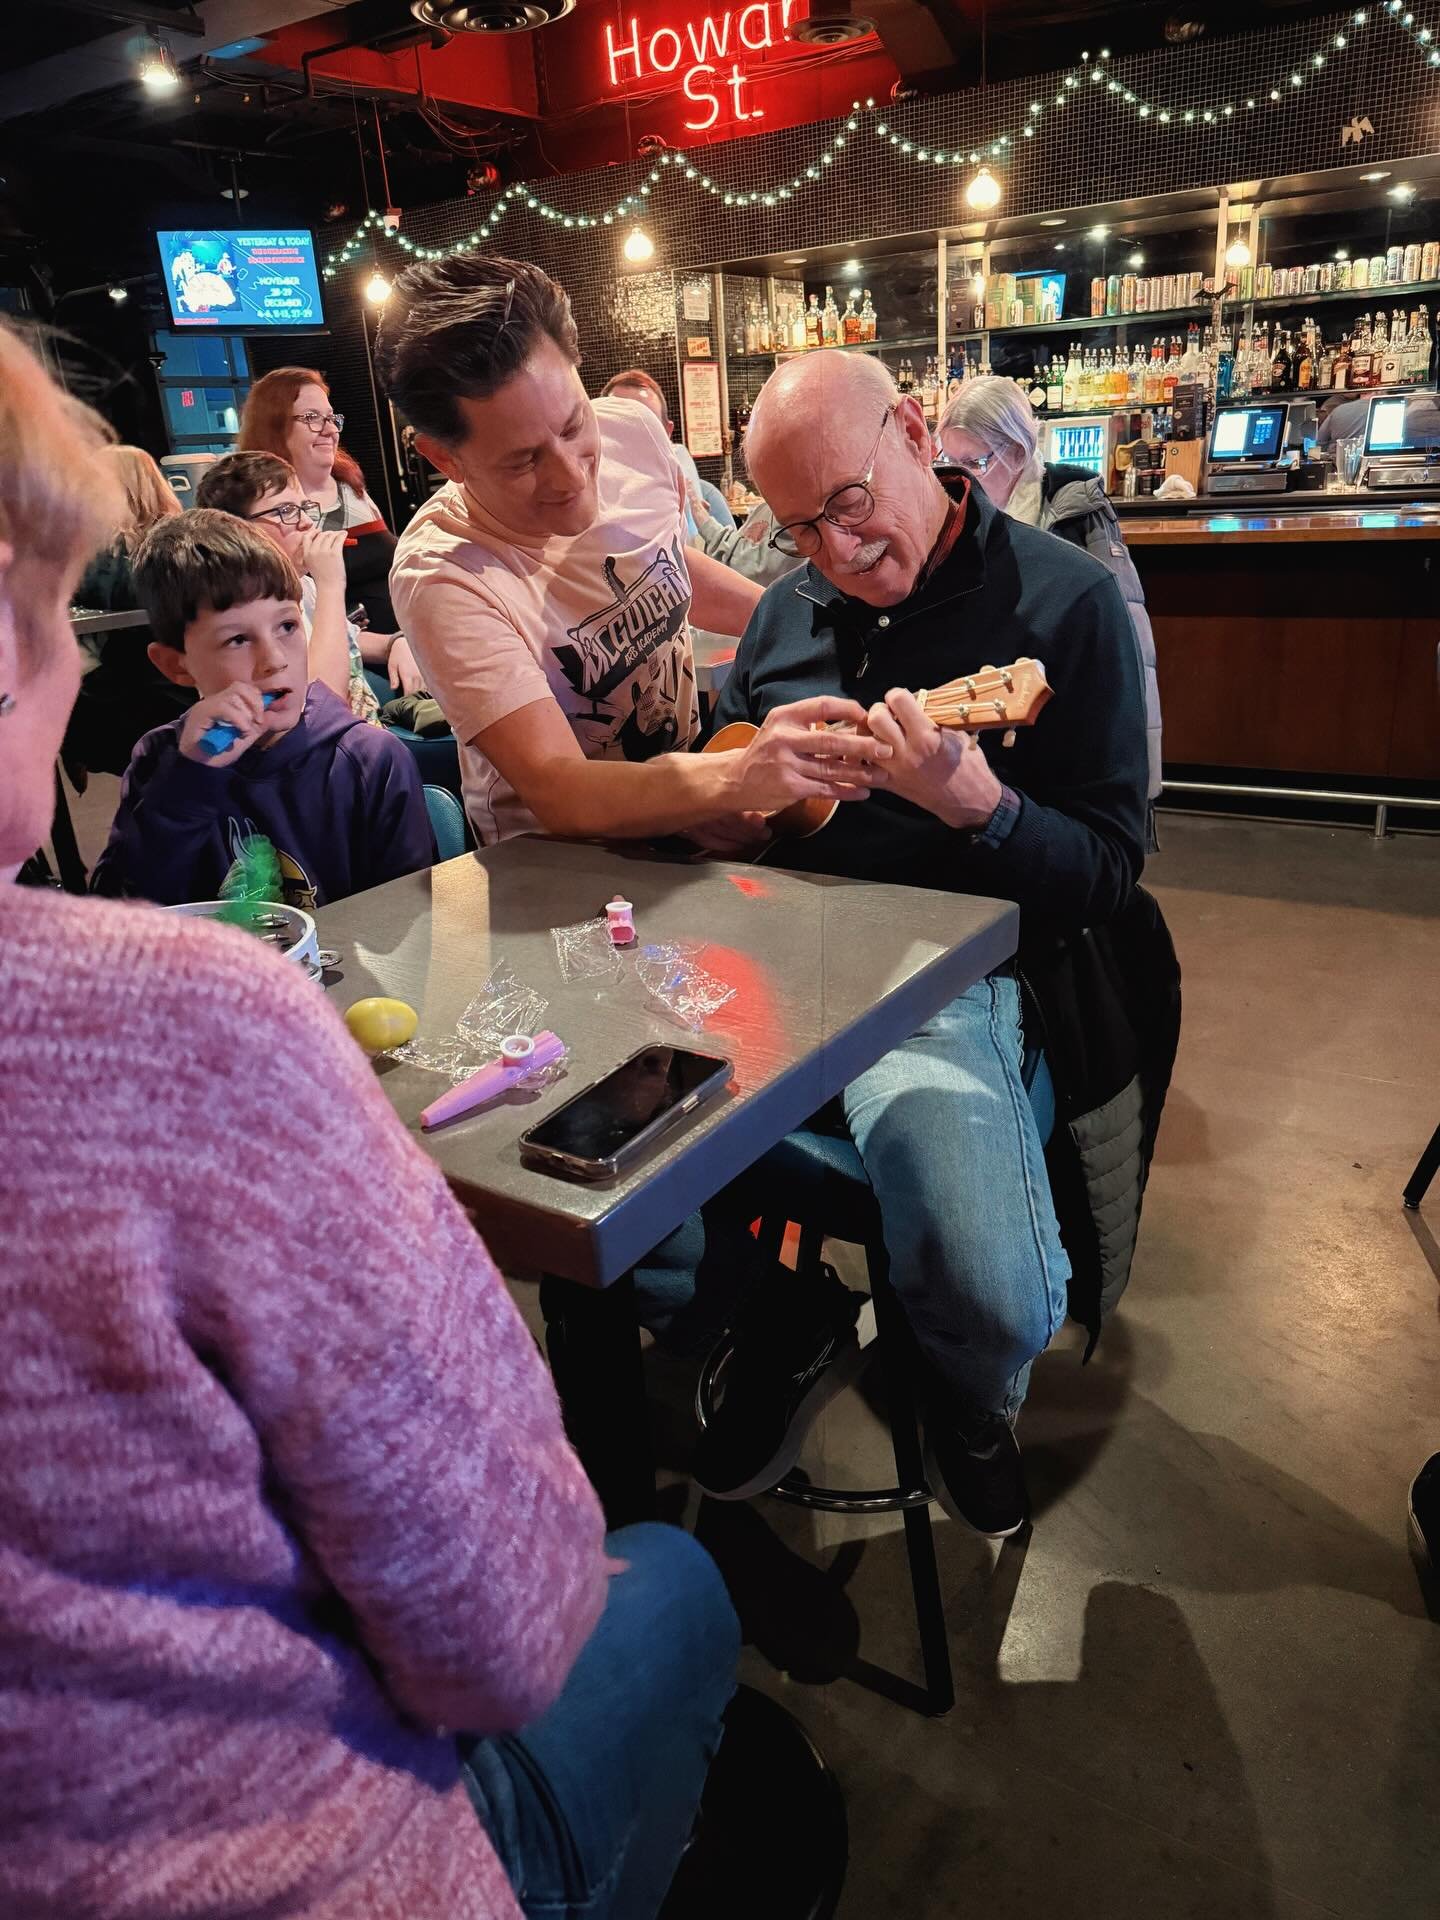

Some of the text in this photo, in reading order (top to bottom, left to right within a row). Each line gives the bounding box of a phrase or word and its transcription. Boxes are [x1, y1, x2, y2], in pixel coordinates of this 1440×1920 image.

[683, 64, 764, 130] St.
[237, 237, 310, 246] YESTERDAY & TODAY
[260, 276, 300, 285] NOVEMBER
[264, 298, 302, 307] DECEMBER
[636, 619, 668, 652] ACADEMY
